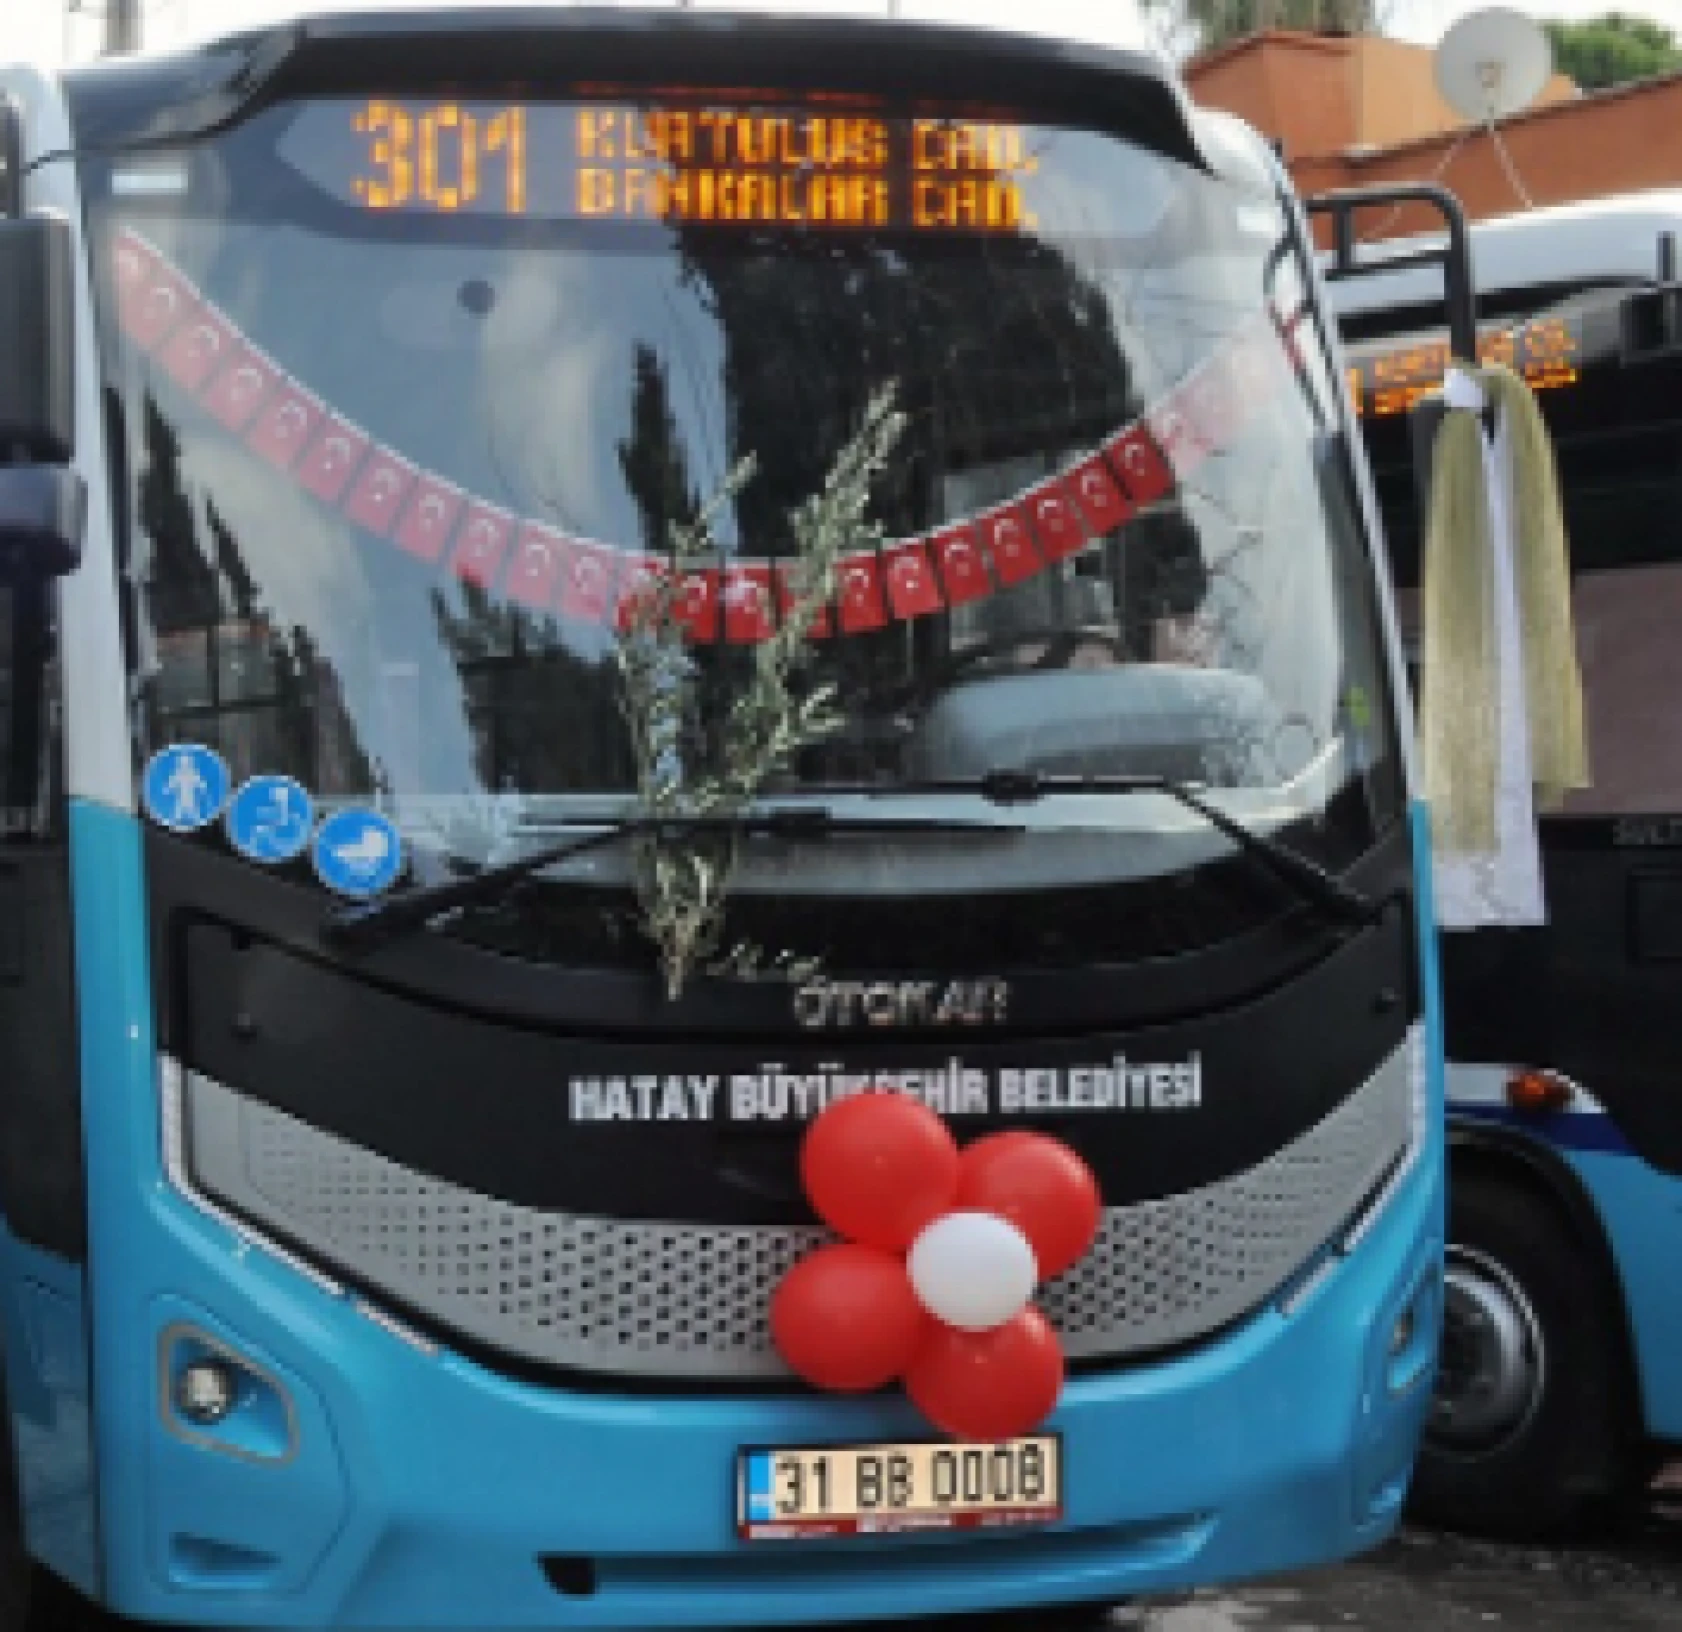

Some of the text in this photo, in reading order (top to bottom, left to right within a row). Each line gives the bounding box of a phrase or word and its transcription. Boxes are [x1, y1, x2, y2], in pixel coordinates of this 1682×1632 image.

[351, 100, 526, 214] 301
[568, 1074, 720, 1120] HATAY
[998, 1050, 1202, 1113] BELEDİYESİ
[776, 1443, 1046, 1514] 31 BB 0008
